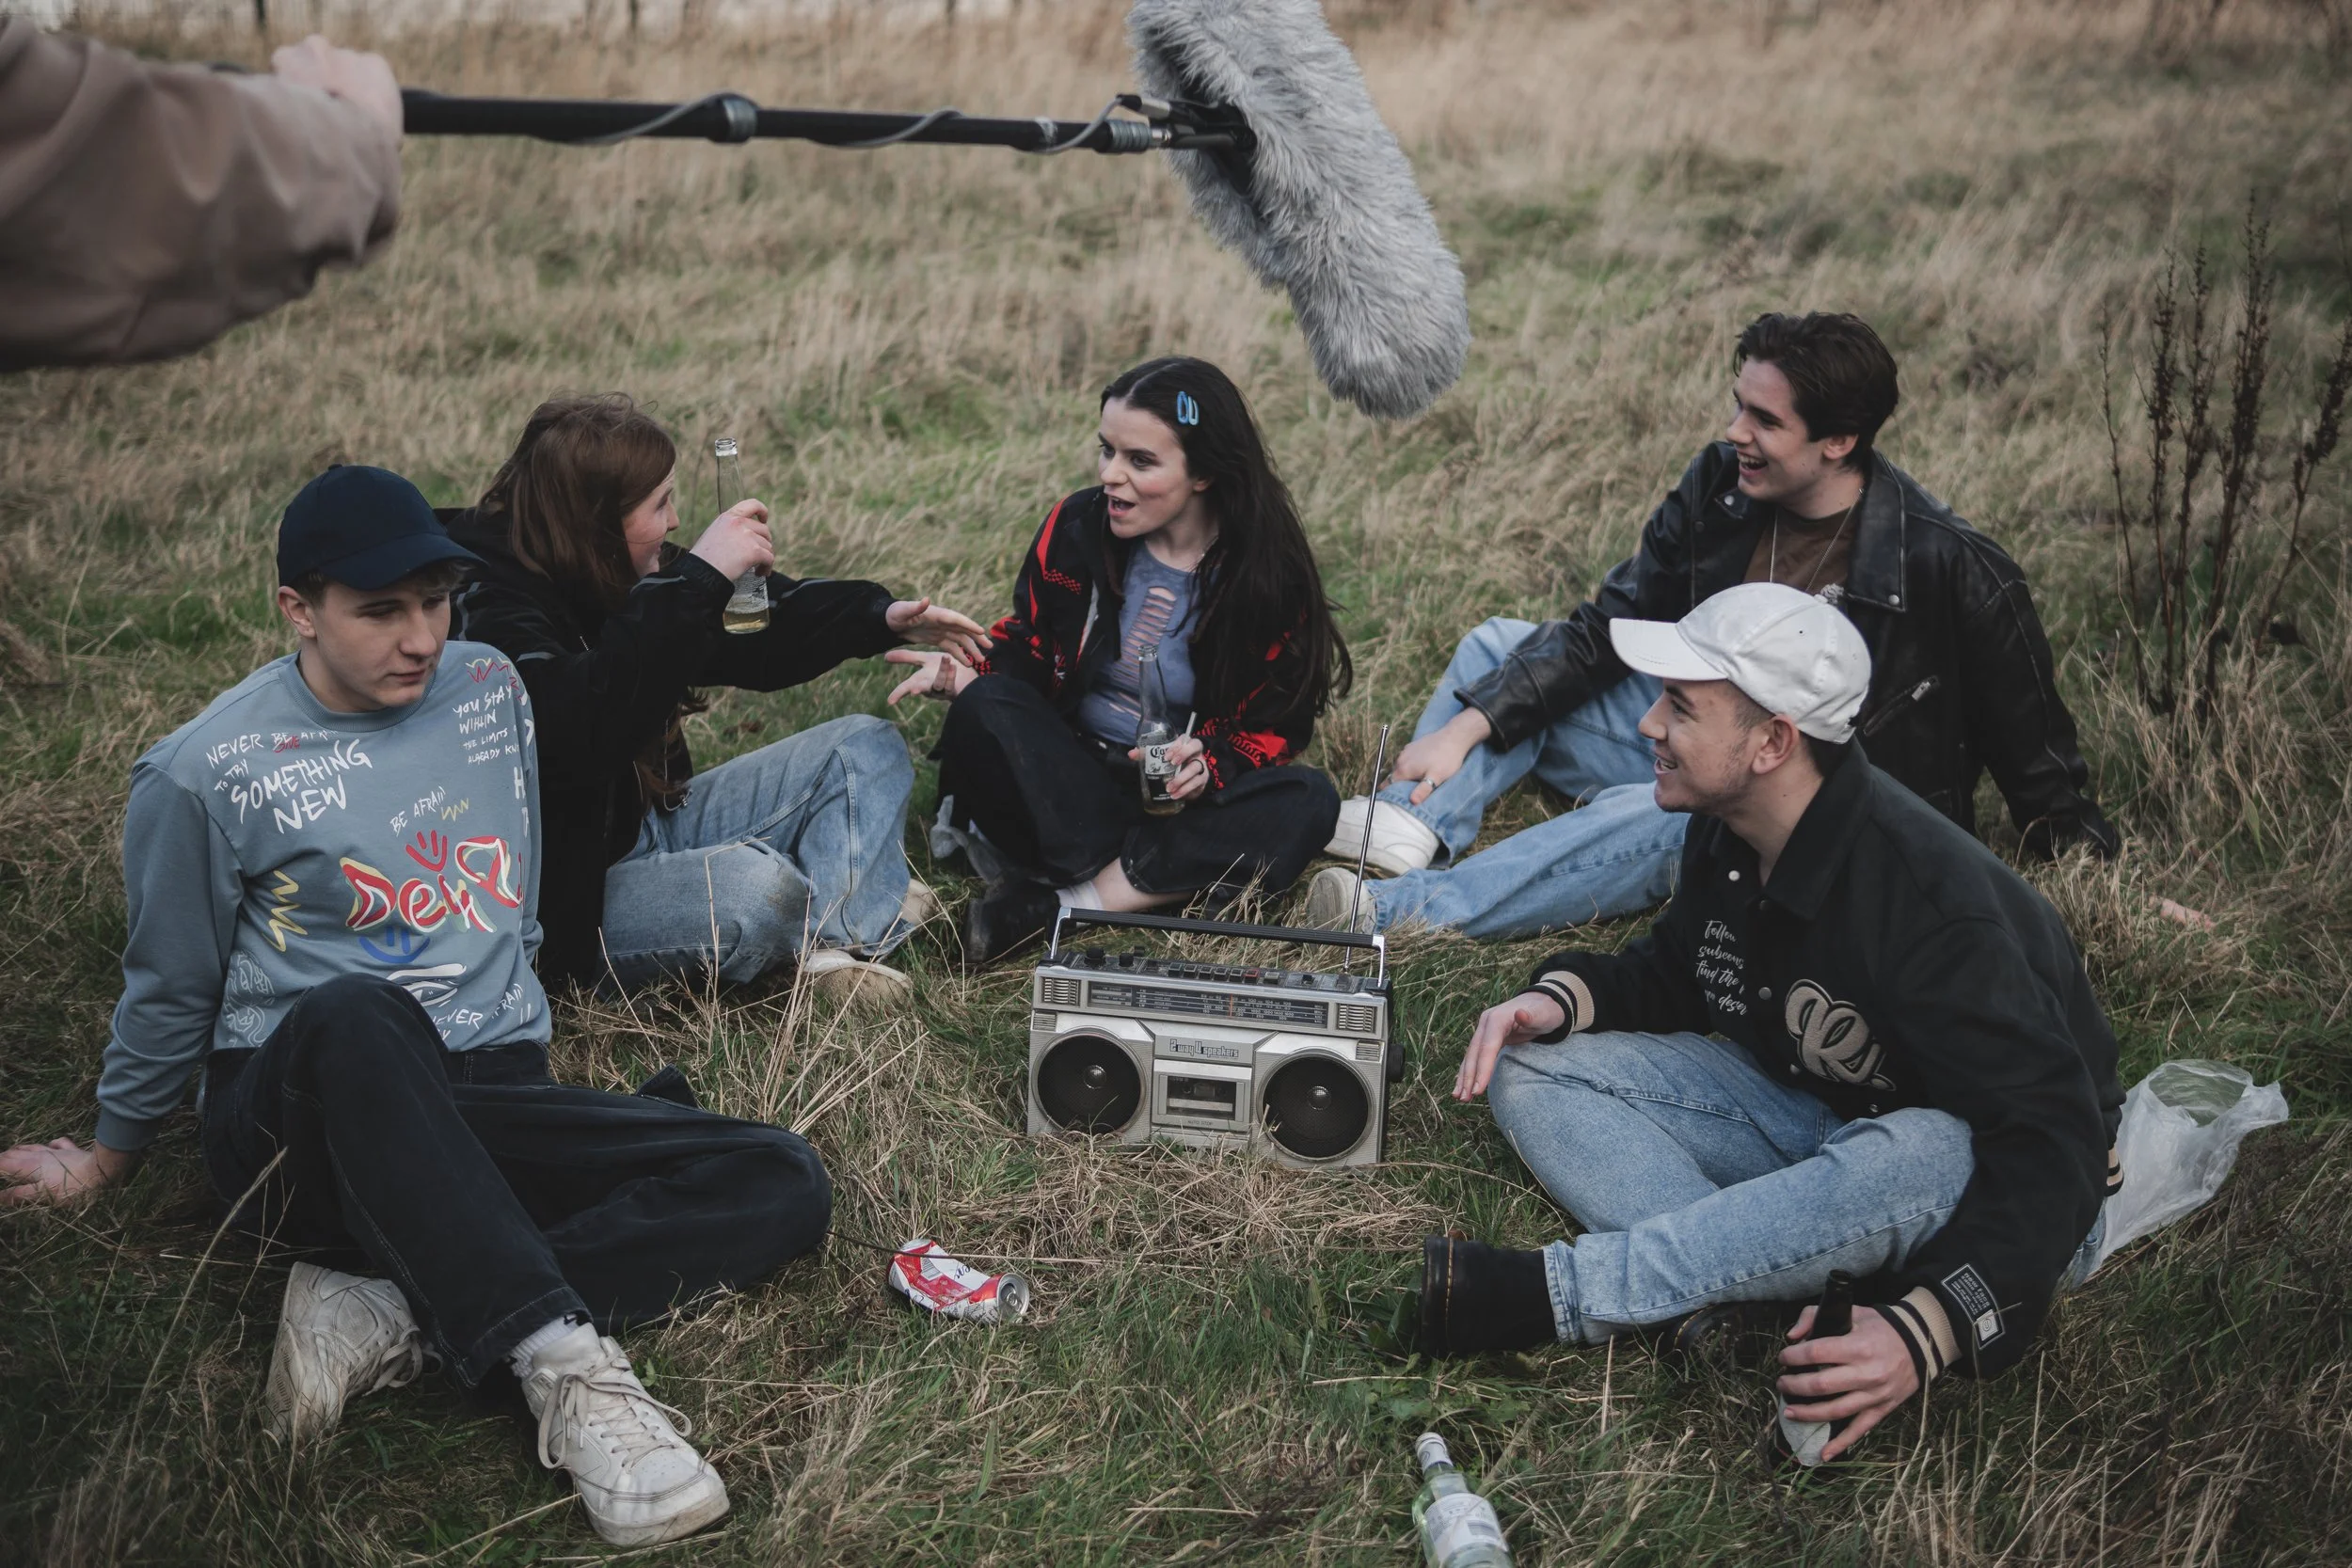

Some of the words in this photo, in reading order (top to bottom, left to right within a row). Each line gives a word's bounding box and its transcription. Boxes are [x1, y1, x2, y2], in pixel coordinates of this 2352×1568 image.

[205, 733, 264, 769] NEVER
[214, 779, 229, 792] TO
[224, 758, 249, 780] TRY
[230, 738, 373, 825] SOMETHING
[273, 774, 347, 834] NEW
[389, 810, 408, 837] BE
[1718, 968, 1740, 988] the
